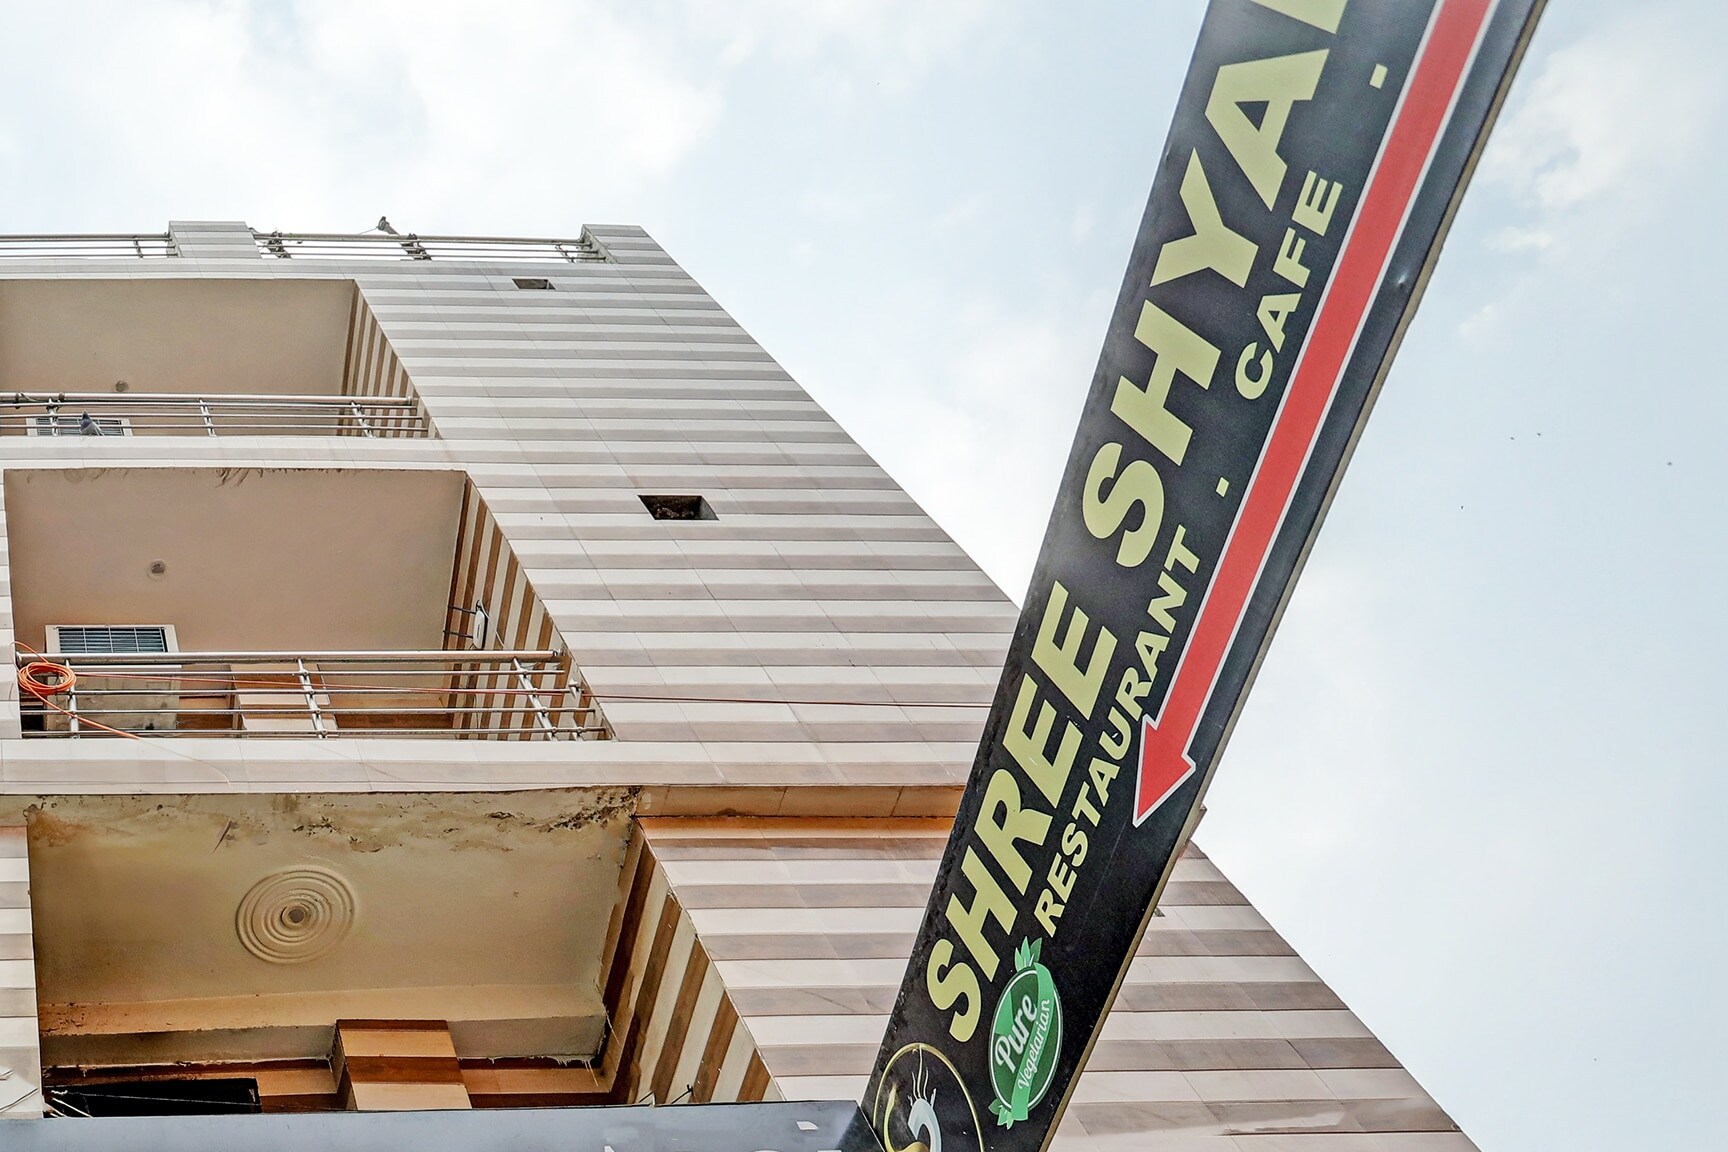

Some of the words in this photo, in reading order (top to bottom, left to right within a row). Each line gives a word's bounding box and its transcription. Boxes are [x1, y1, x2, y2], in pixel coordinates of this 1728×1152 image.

[1032, 524, 1203, 938] RESTAURANT
[1235, 170, 1343, 400] CAFE
[926, 580, 1119, 1043] SHREE
[995, 994, 1038, 1073] Pure
[1017, 999, 1051, 1091] Vegetarian
